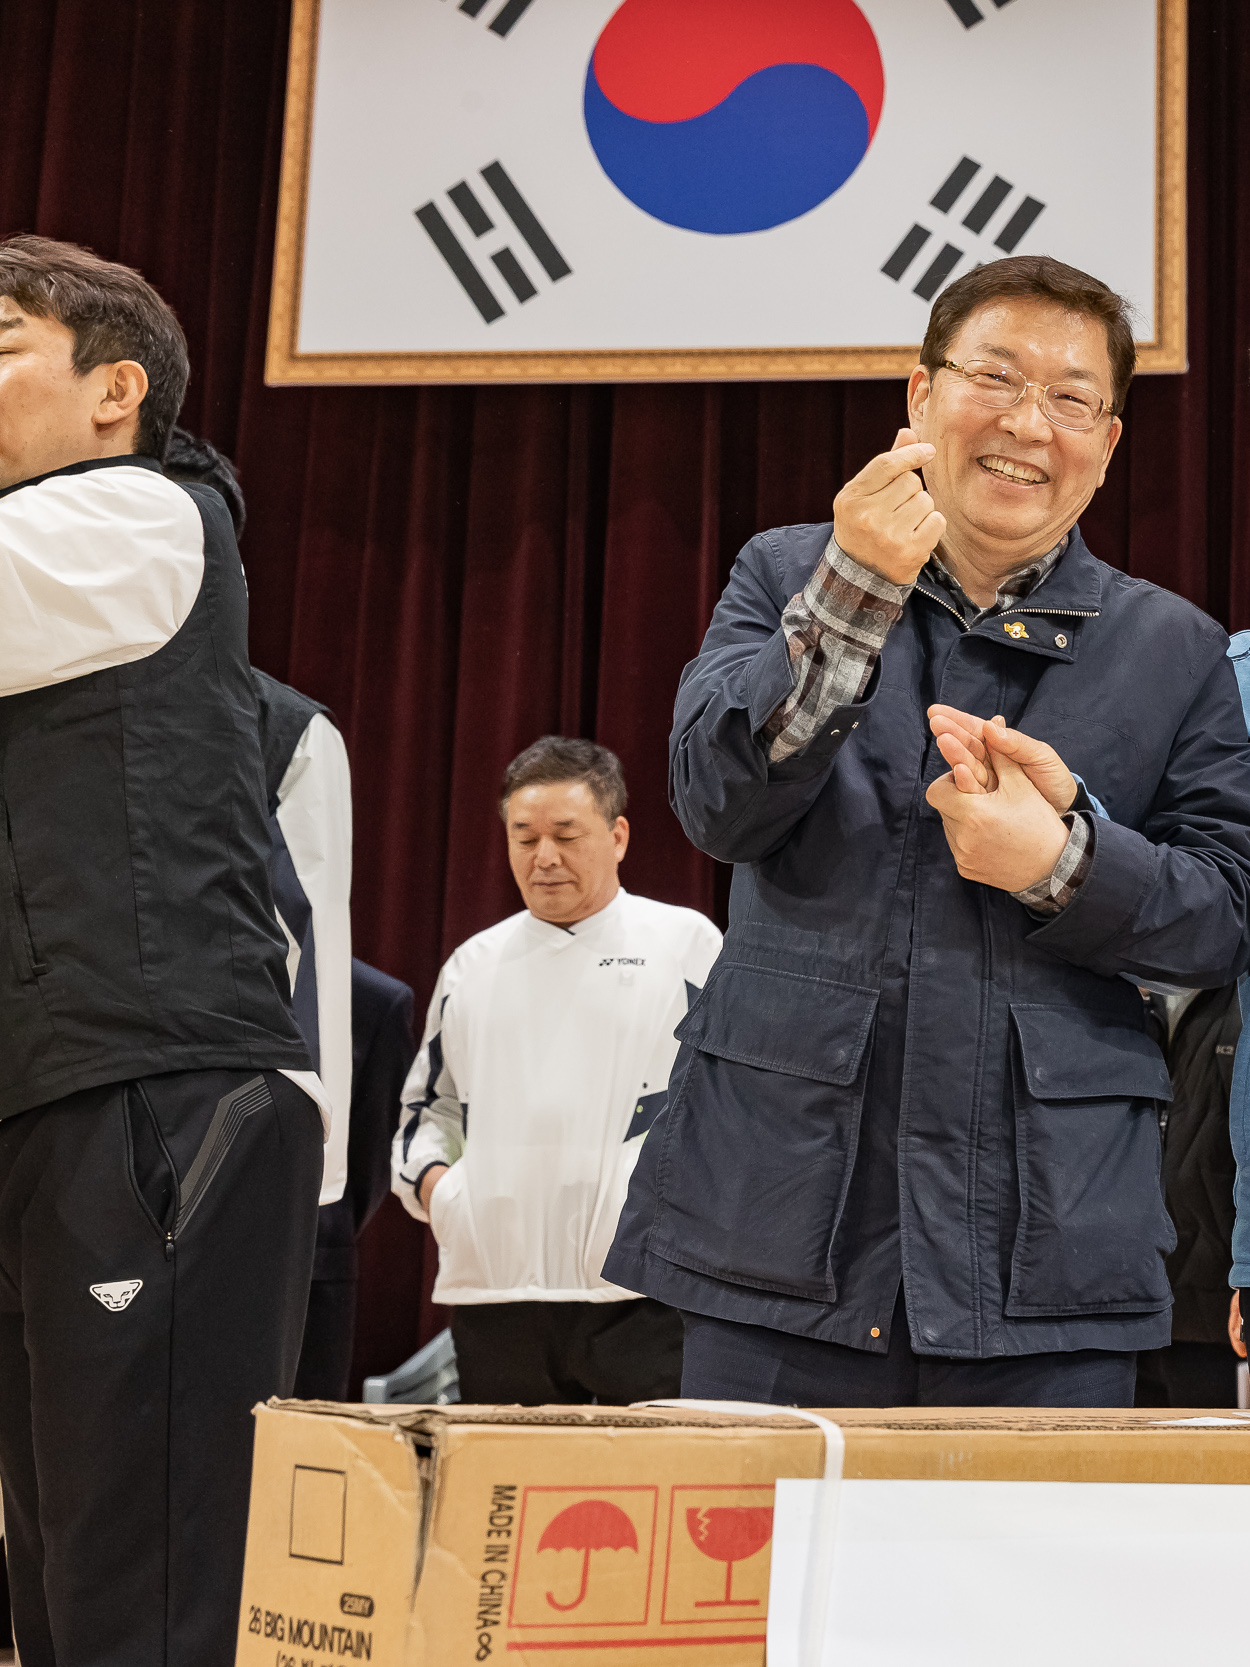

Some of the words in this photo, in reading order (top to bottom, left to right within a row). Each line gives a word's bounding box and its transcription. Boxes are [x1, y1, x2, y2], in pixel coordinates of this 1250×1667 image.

[487, 1484, 517, 1539] MADE
[484, 1543, 510, 1564] IN
[475, 1568, 507, 1631] CHINA
[248, 1604, 262, 1636] 26
[264, 1610, 286, 1642] BIG
[287, 1616, 372, 1661] MOUNTAIN
